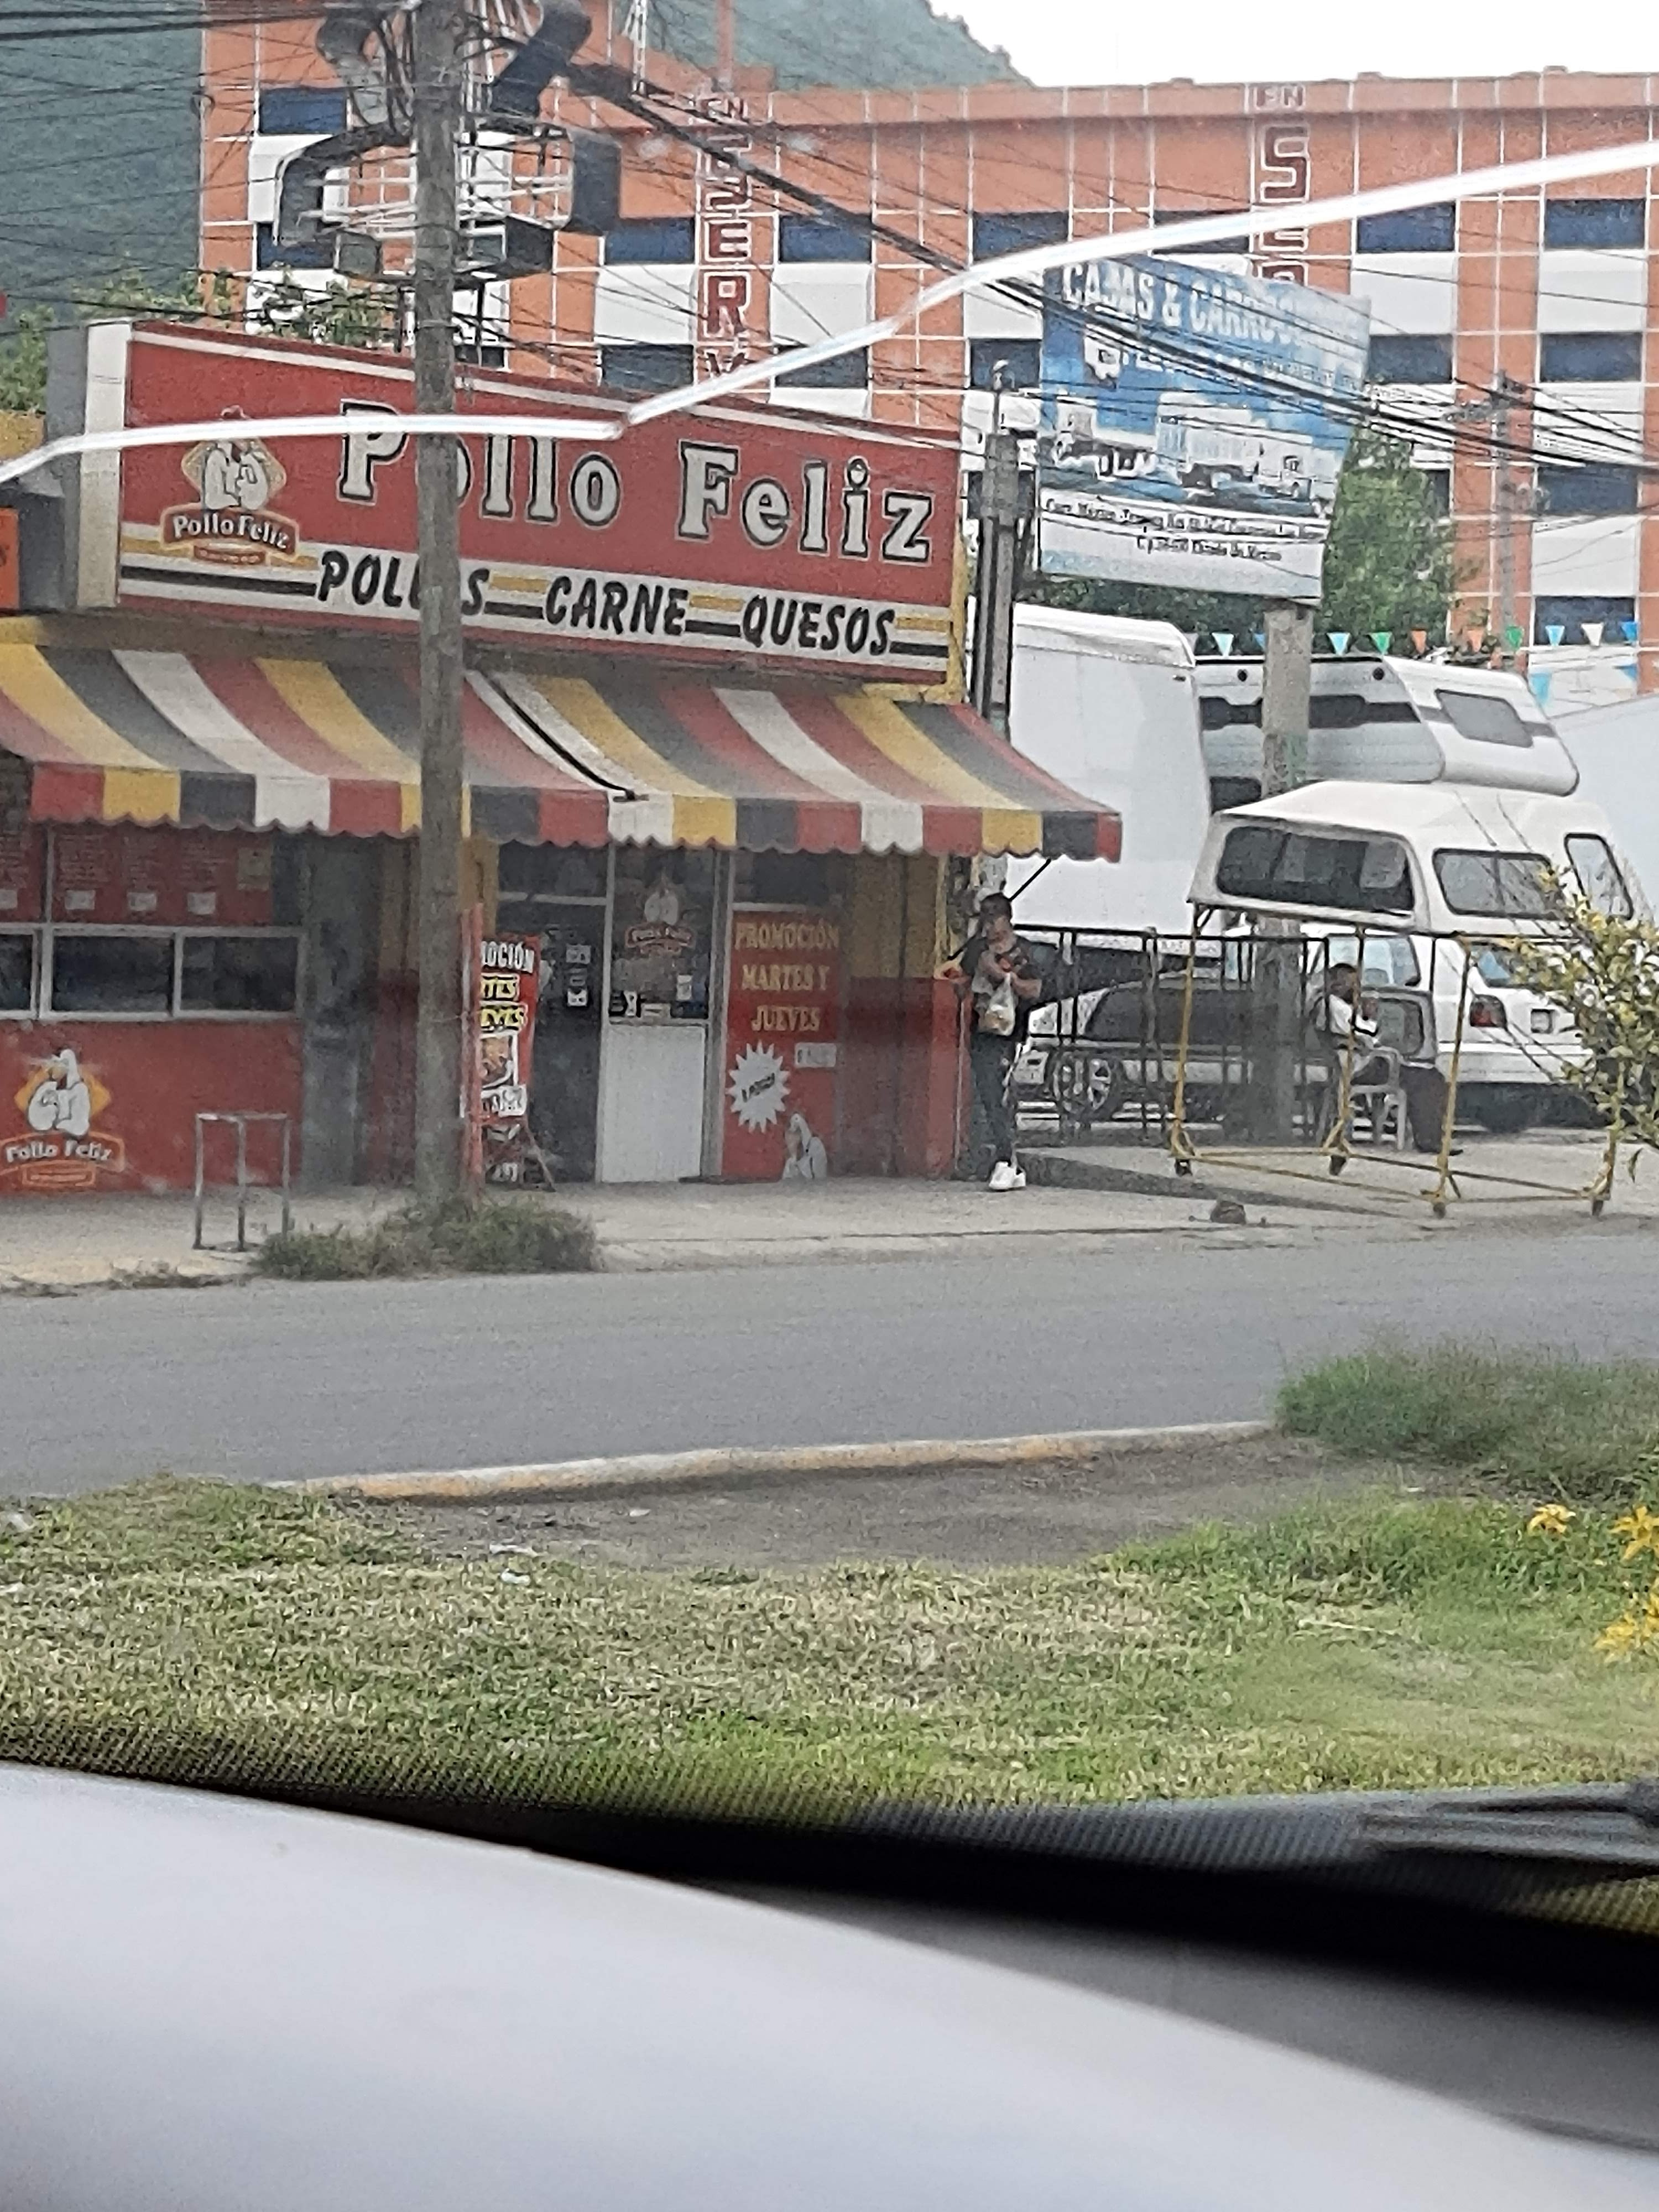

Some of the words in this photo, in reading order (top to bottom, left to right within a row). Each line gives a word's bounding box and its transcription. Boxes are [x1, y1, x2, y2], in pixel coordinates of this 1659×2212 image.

[336, 398, 622, 528] Pllo
[675, 439, 935, 564] Feliz
[173, 512, 234, 539] Pollo
[238, 514, 290, 550] Feliz
[317, 550, 491, 616] POLS
[545, 575, 689, 636] CARNE
[741, 594, 896, 657] QUESOS
[734, 918, 839, 951] PROMOCIÓN
[742, 964, 815, 992] MARTES
[818, 964, 831, 991] Y
[750, 1004, 821, 1032] JUEVES
